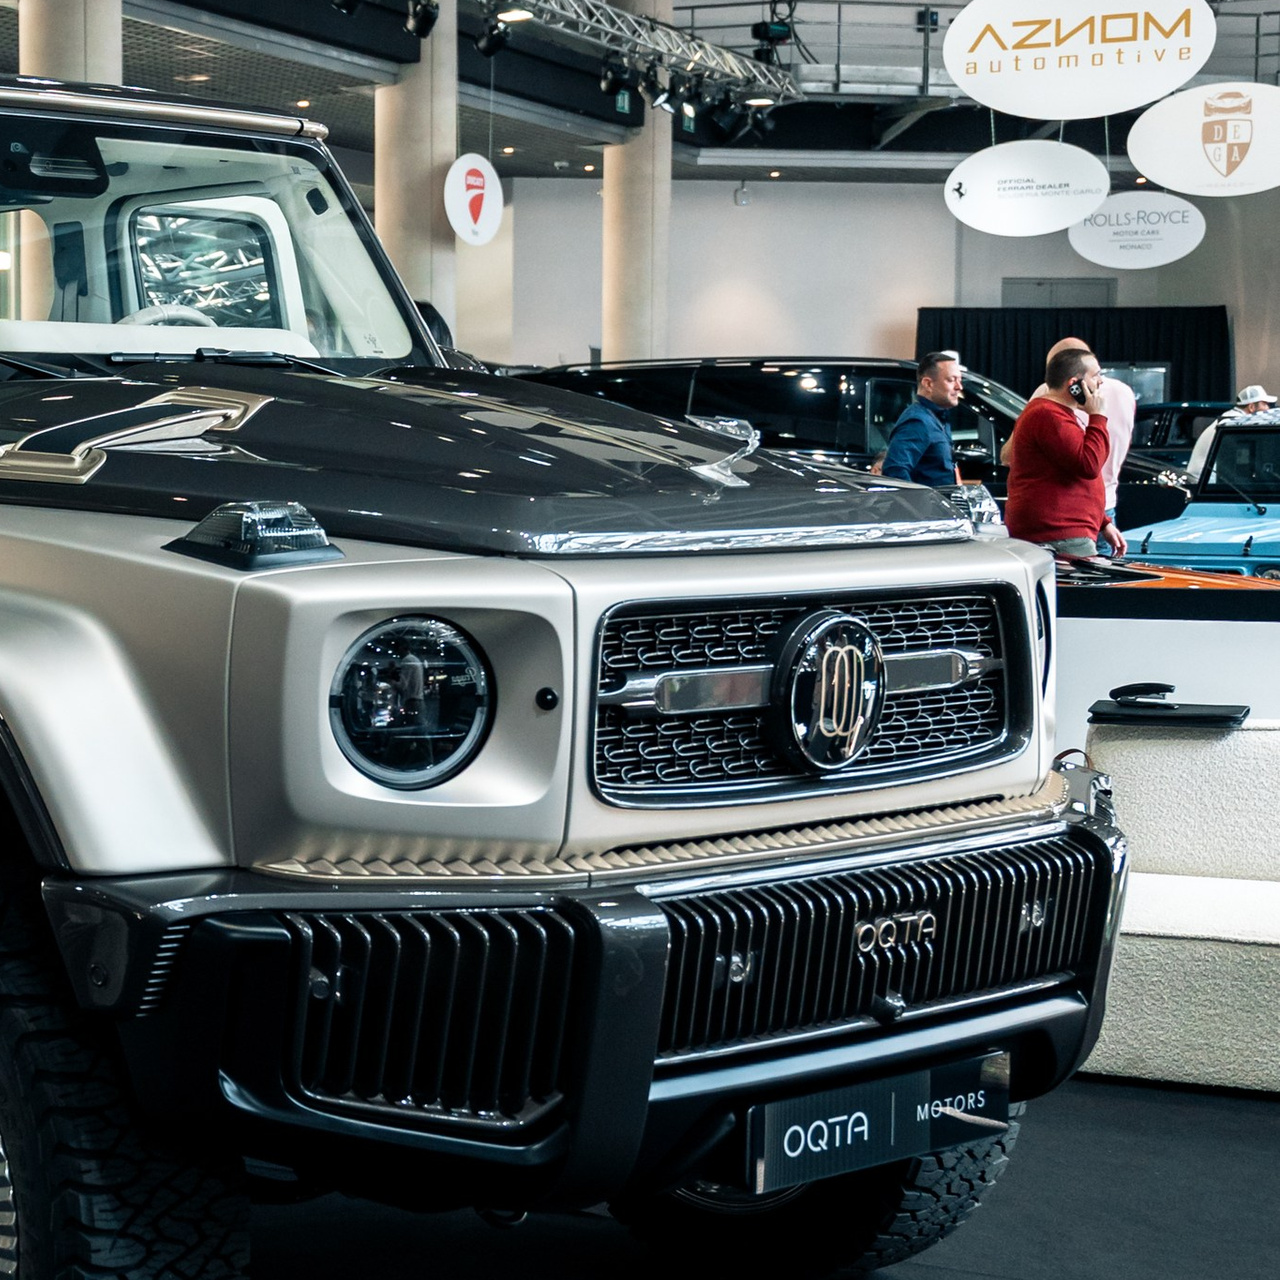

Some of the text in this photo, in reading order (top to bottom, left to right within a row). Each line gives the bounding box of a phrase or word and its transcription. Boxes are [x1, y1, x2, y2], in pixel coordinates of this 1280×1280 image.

[965, 46, 1191, 75] automotive
[1035, 183, 1070, 191] DEALER
[1112, 228, 1160, 237] MOTOR CARS
[1119, 243, 1152, 251] MONACO
[856, 911, 936, 952] OQTA
[783, 1090, 986, 1158] OQTA MOTORS
